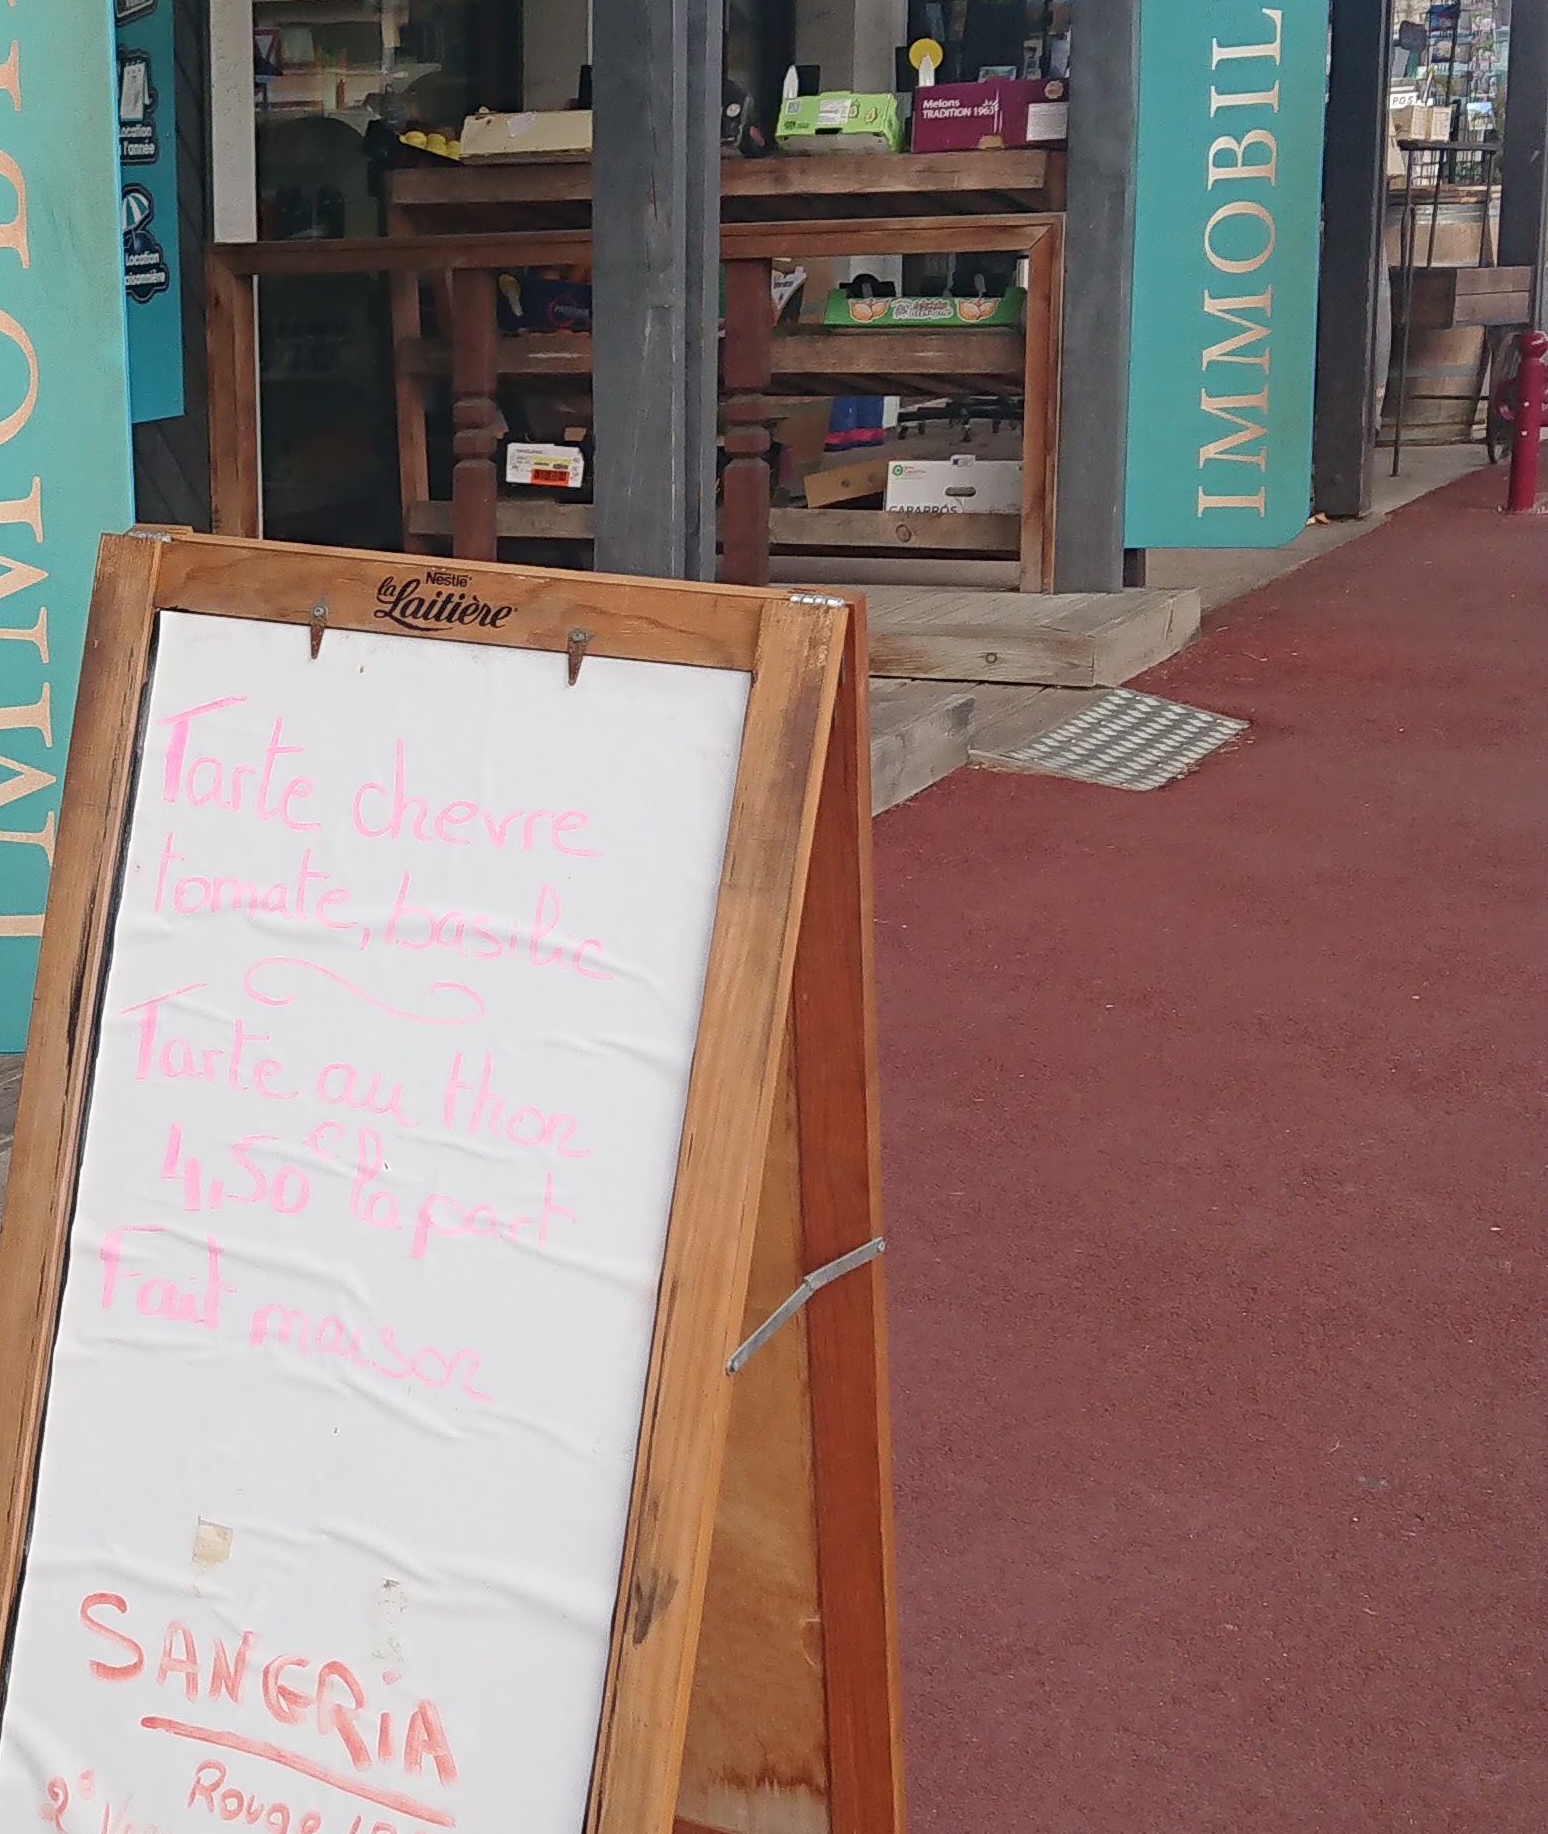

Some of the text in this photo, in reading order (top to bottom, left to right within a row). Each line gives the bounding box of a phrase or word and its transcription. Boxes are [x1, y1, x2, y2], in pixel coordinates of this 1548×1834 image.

[120, 124, 152, 138] ocation
[922, 98, 960, 109] Melons
[922, 108, 971, 119] TRADITION
[373, 578, 513, 632] Laitière
[153, 695, 322, 832] Tarte
[384, 871, 615, 982] basilic
[120, 983, 591, 1159] Tarte au thon
[348, 1131, 402, 1232] la
[411, 1173, 577, 1259] part
[98, 1224, 496, 1404] Fait maison
